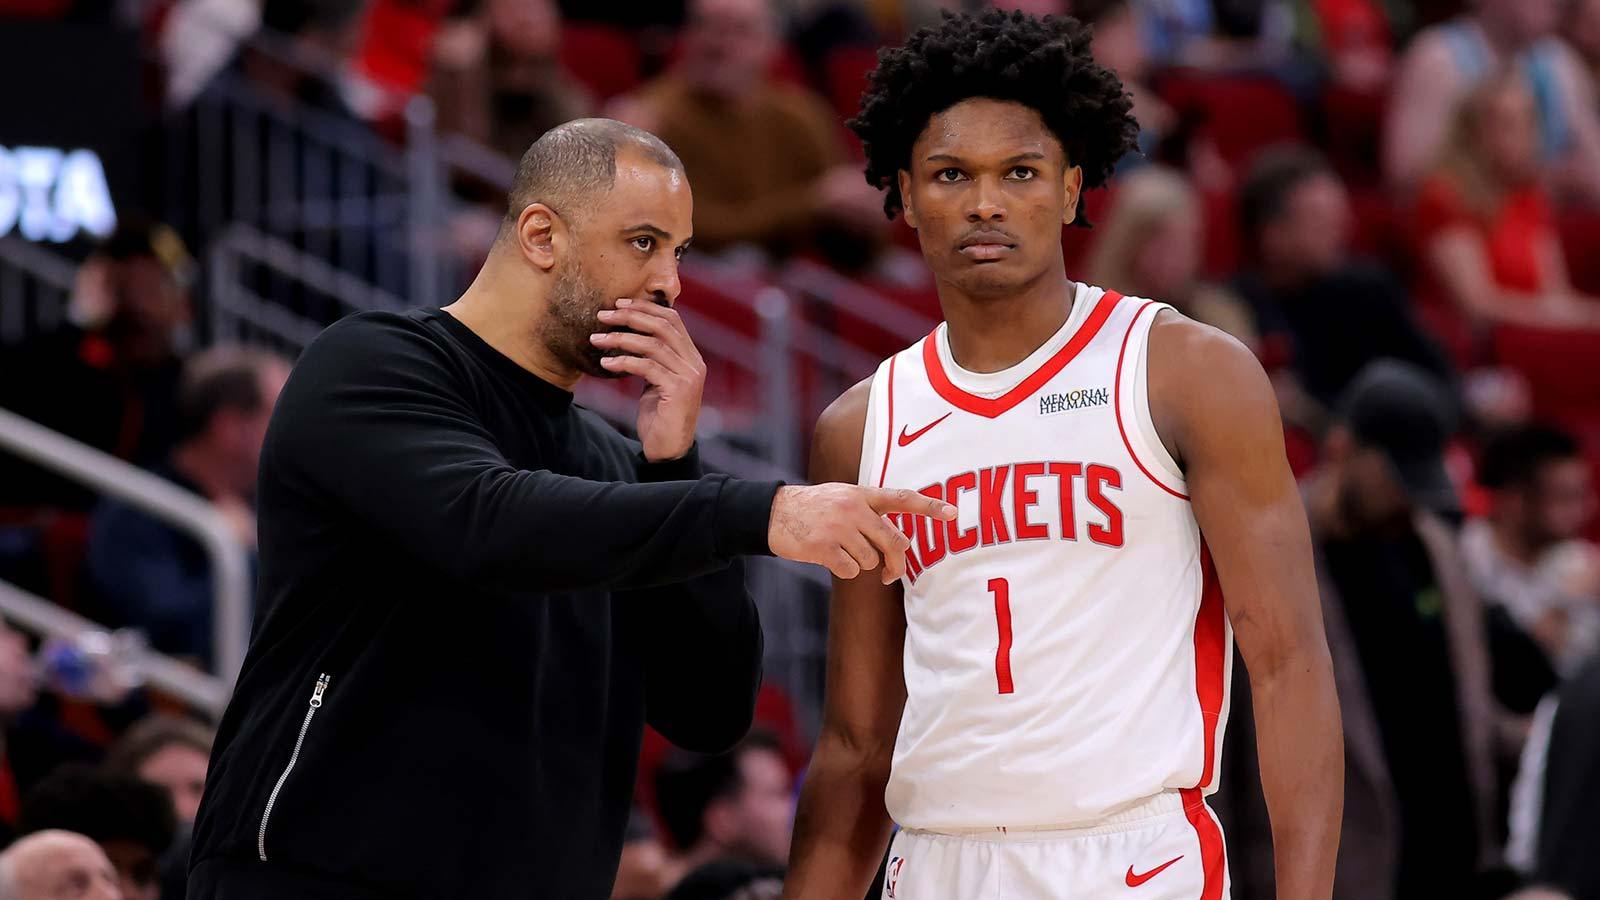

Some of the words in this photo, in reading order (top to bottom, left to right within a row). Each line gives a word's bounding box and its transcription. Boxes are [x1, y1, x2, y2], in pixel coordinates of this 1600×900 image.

[1039, 387, 1109, 407] MEMORIAL
[1039, 394, 1109, 415] HERMANN
[987, 577, 1014, 694] 1
